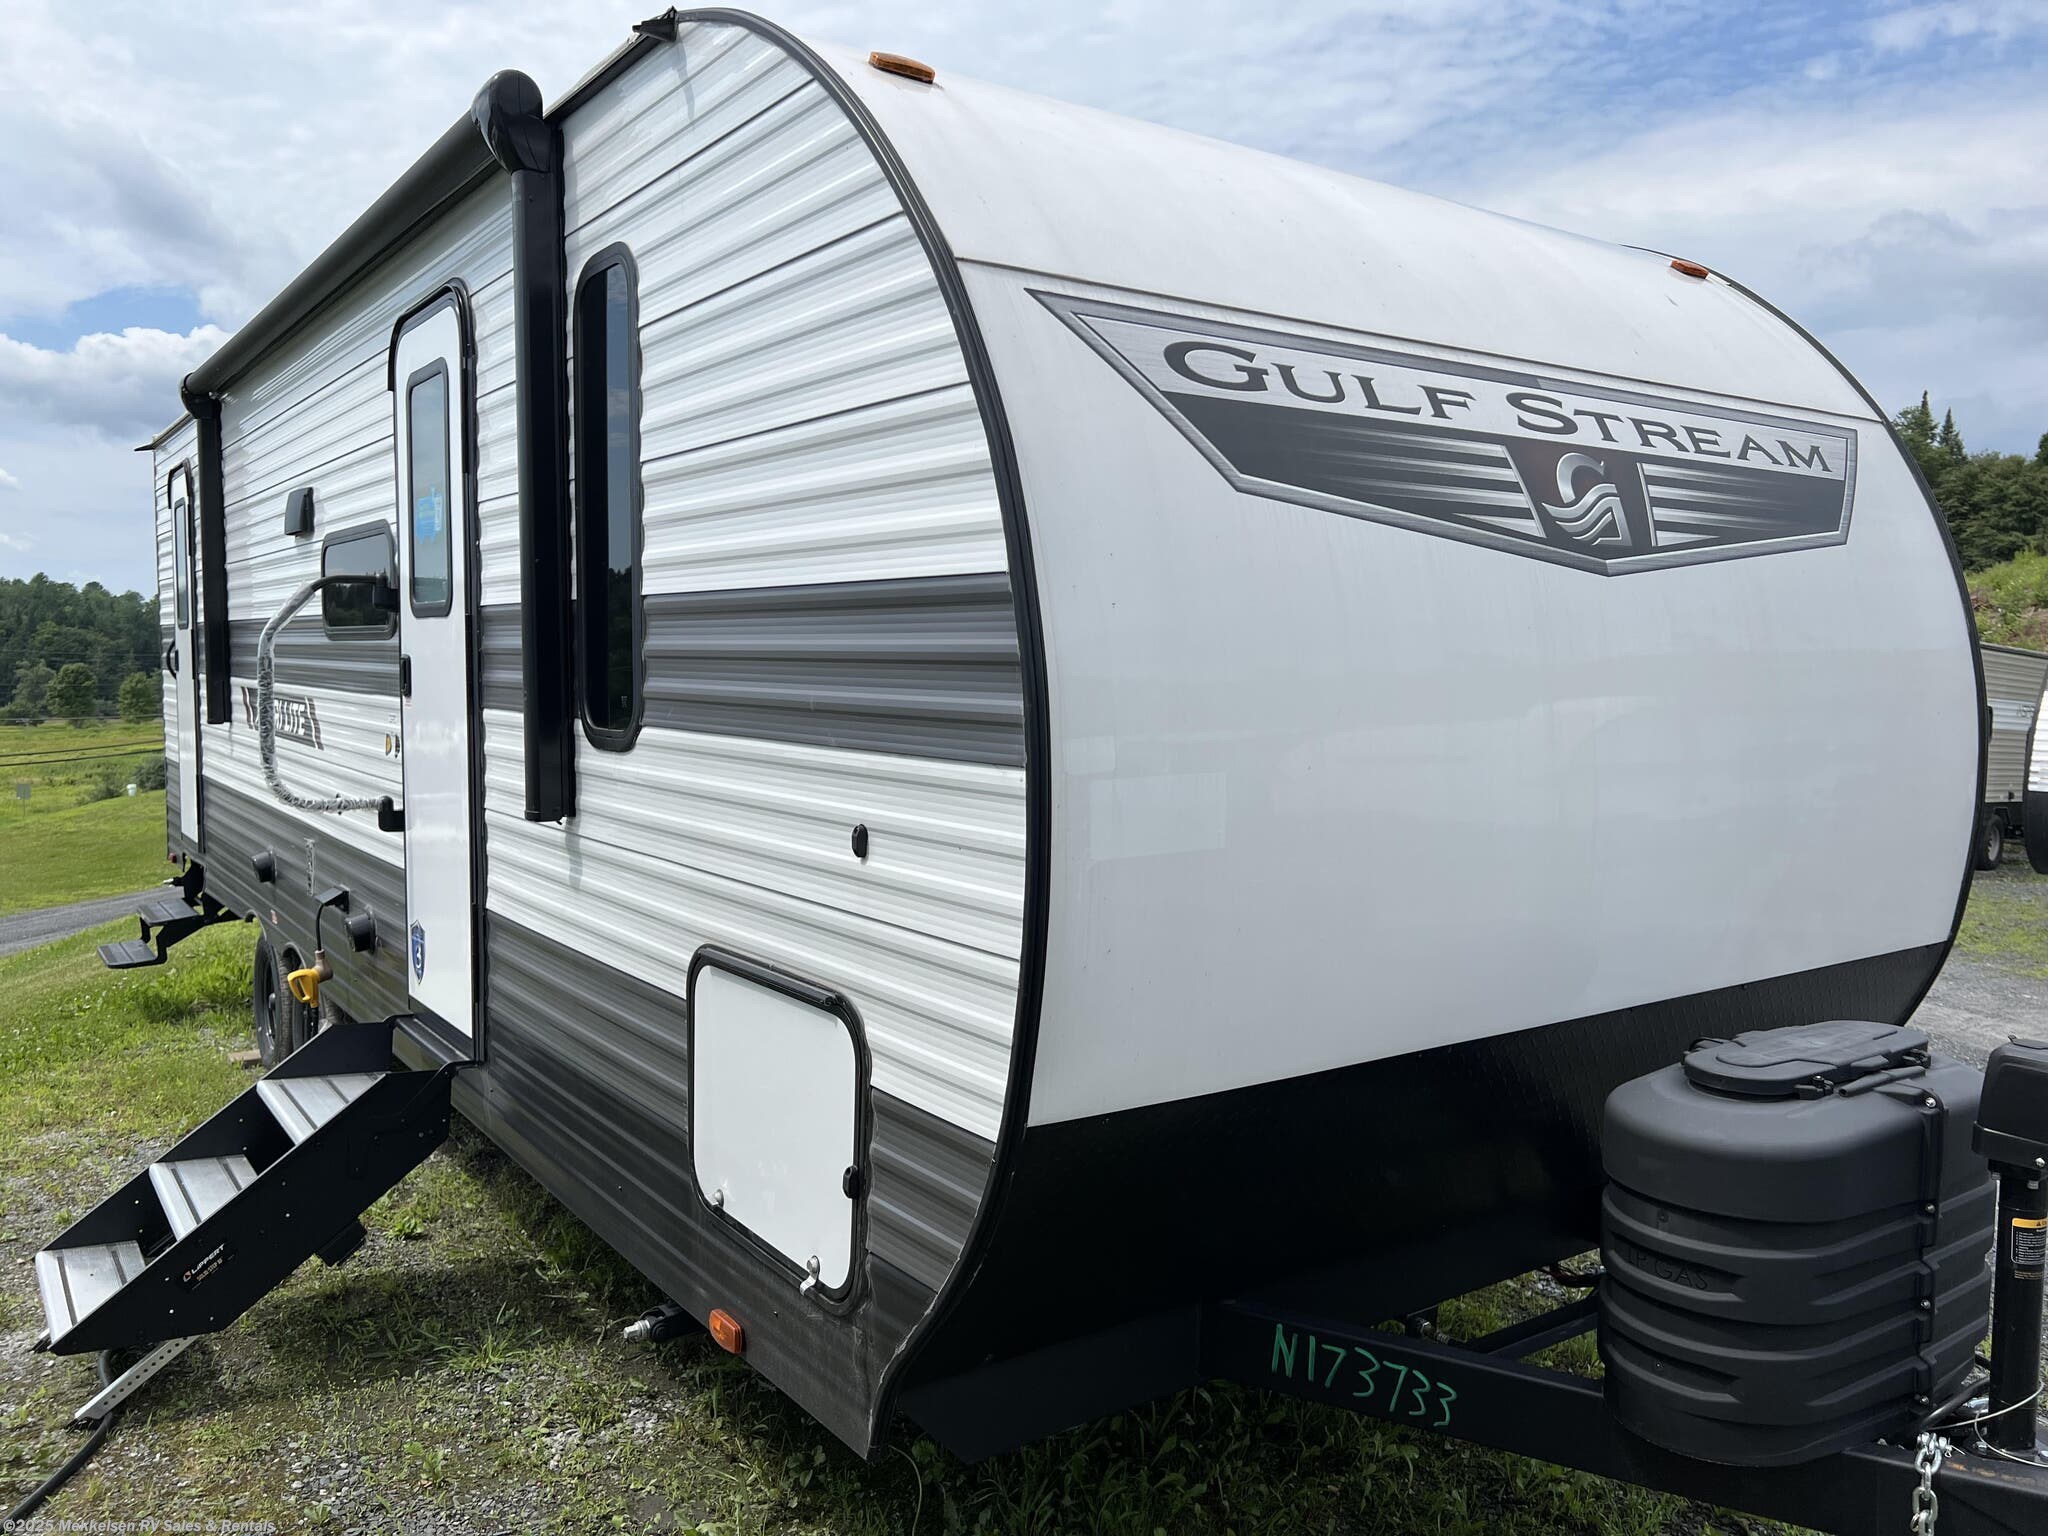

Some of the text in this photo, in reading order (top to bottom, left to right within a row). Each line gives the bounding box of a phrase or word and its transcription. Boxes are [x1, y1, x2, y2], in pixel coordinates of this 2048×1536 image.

[1163, 340, 1833, 473] GULF STREAM
[1654, 1258, 1709, 1291] GAS
[1271, 1323, 1459, 1427] N173733
